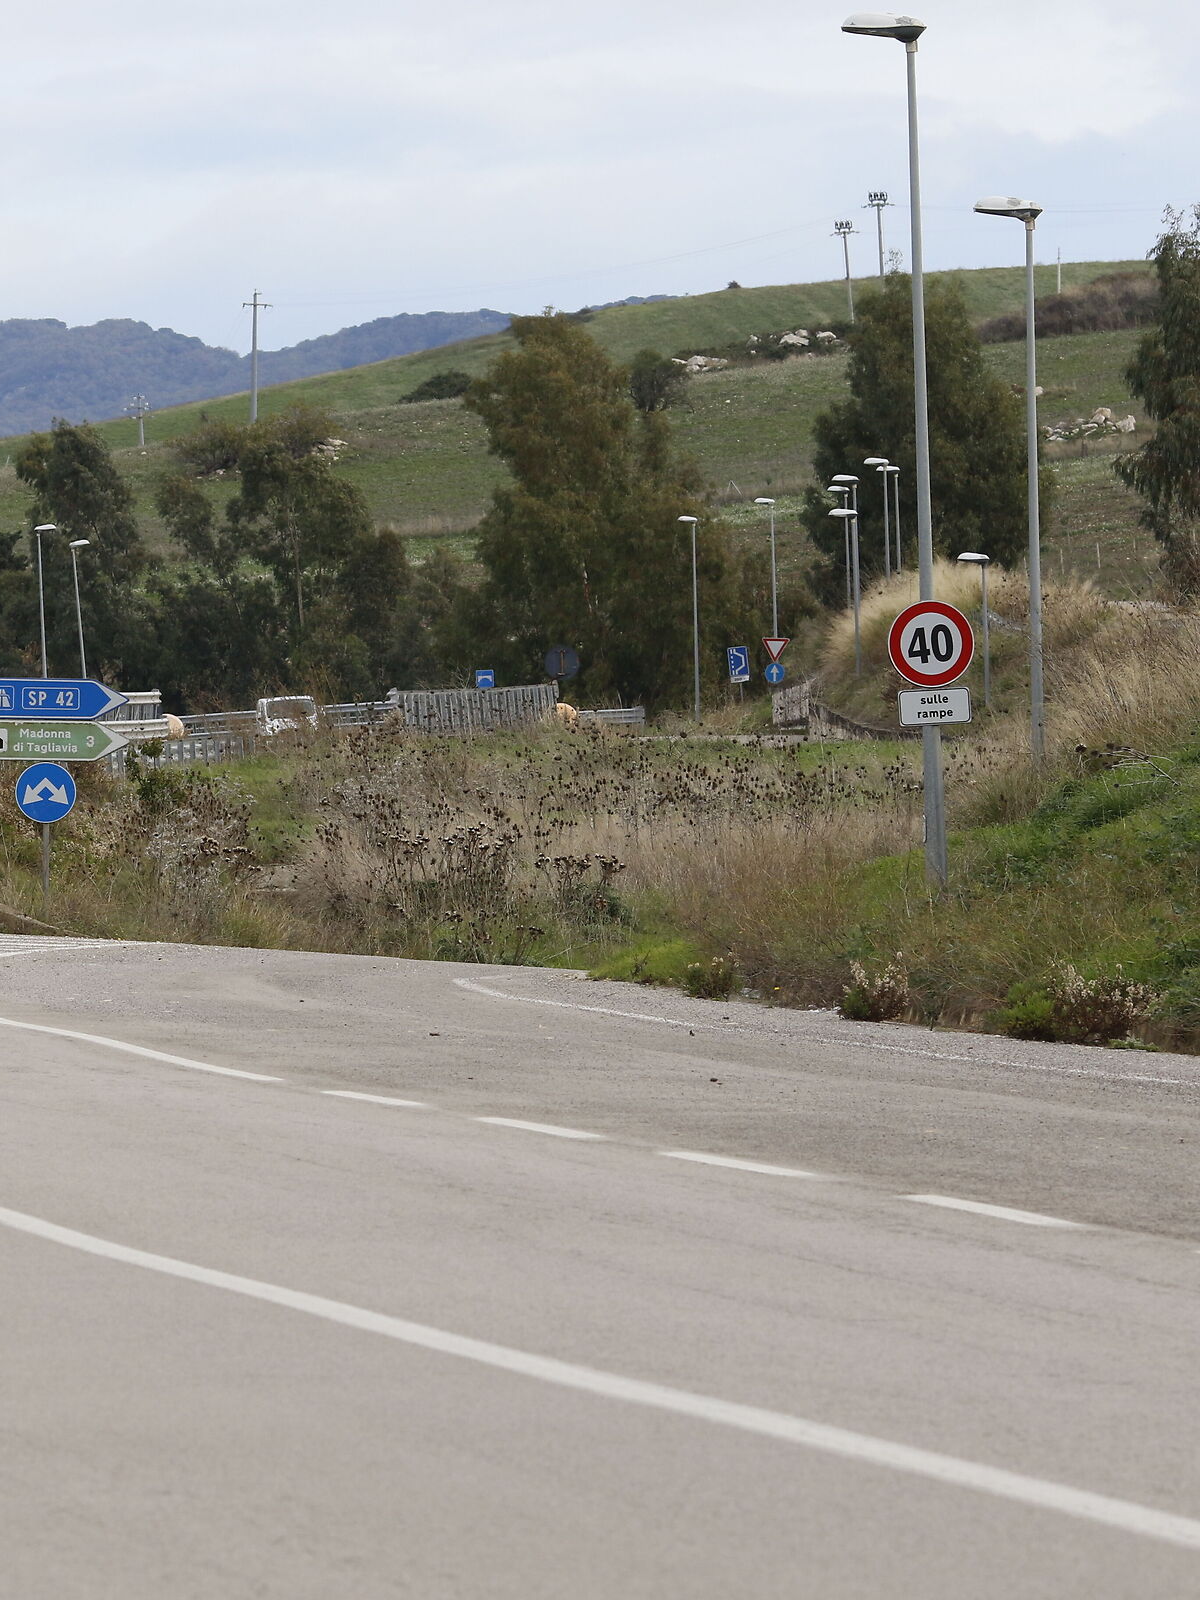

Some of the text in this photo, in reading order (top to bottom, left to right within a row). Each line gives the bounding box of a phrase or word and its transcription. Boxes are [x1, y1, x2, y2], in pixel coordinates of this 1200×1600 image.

[908, 624, 954, 664] 40
[28, 691, 74, 707] SP 42
[920, 694, 949, 705] sulle
[917, 709, 954, 719] rampe
[19, 728, 71, 739] Madonna
[86, 736, 95, 748] 3
[13, 742, 78, 755] di Tagliavia
